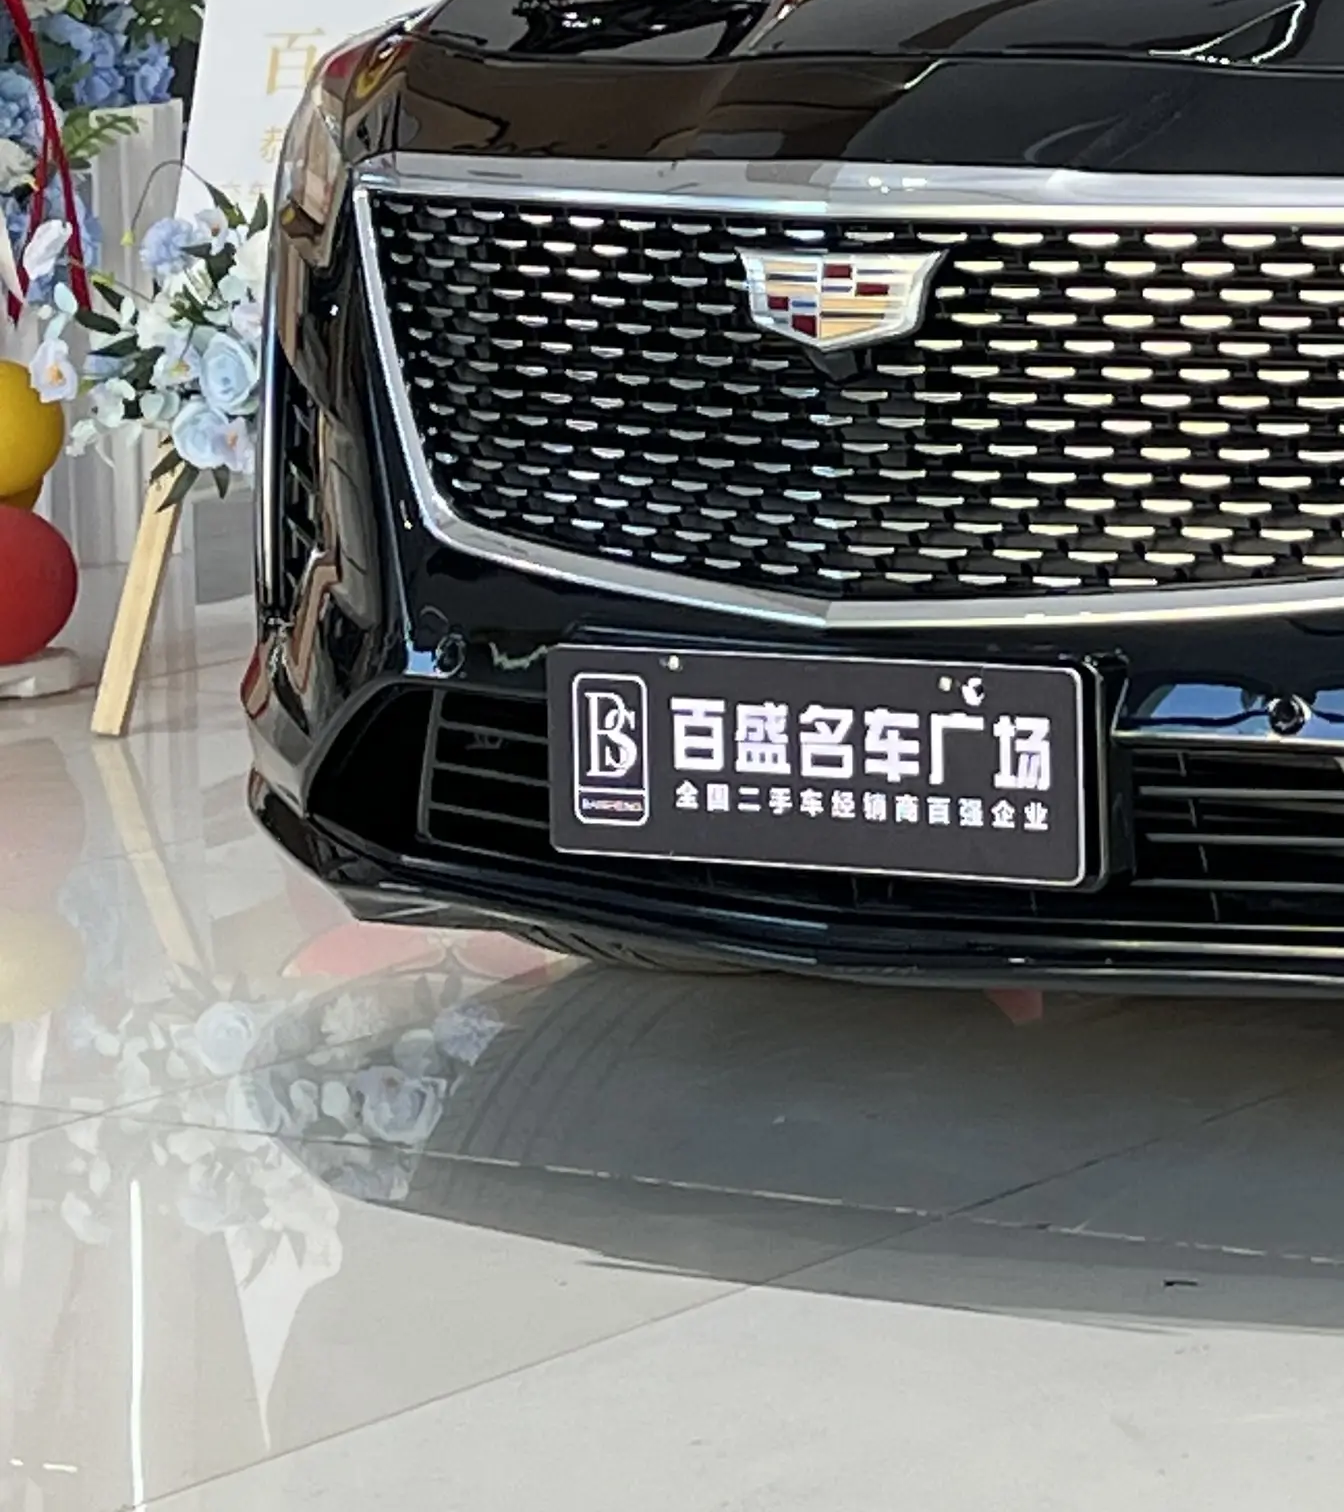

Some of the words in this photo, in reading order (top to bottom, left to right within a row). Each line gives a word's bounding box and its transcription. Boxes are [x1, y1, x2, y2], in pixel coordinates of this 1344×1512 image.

[670, 696, 1051, 792] 百盛名车广场
[675, 780, 1049, 831] 全国二手车经销商百强企业
